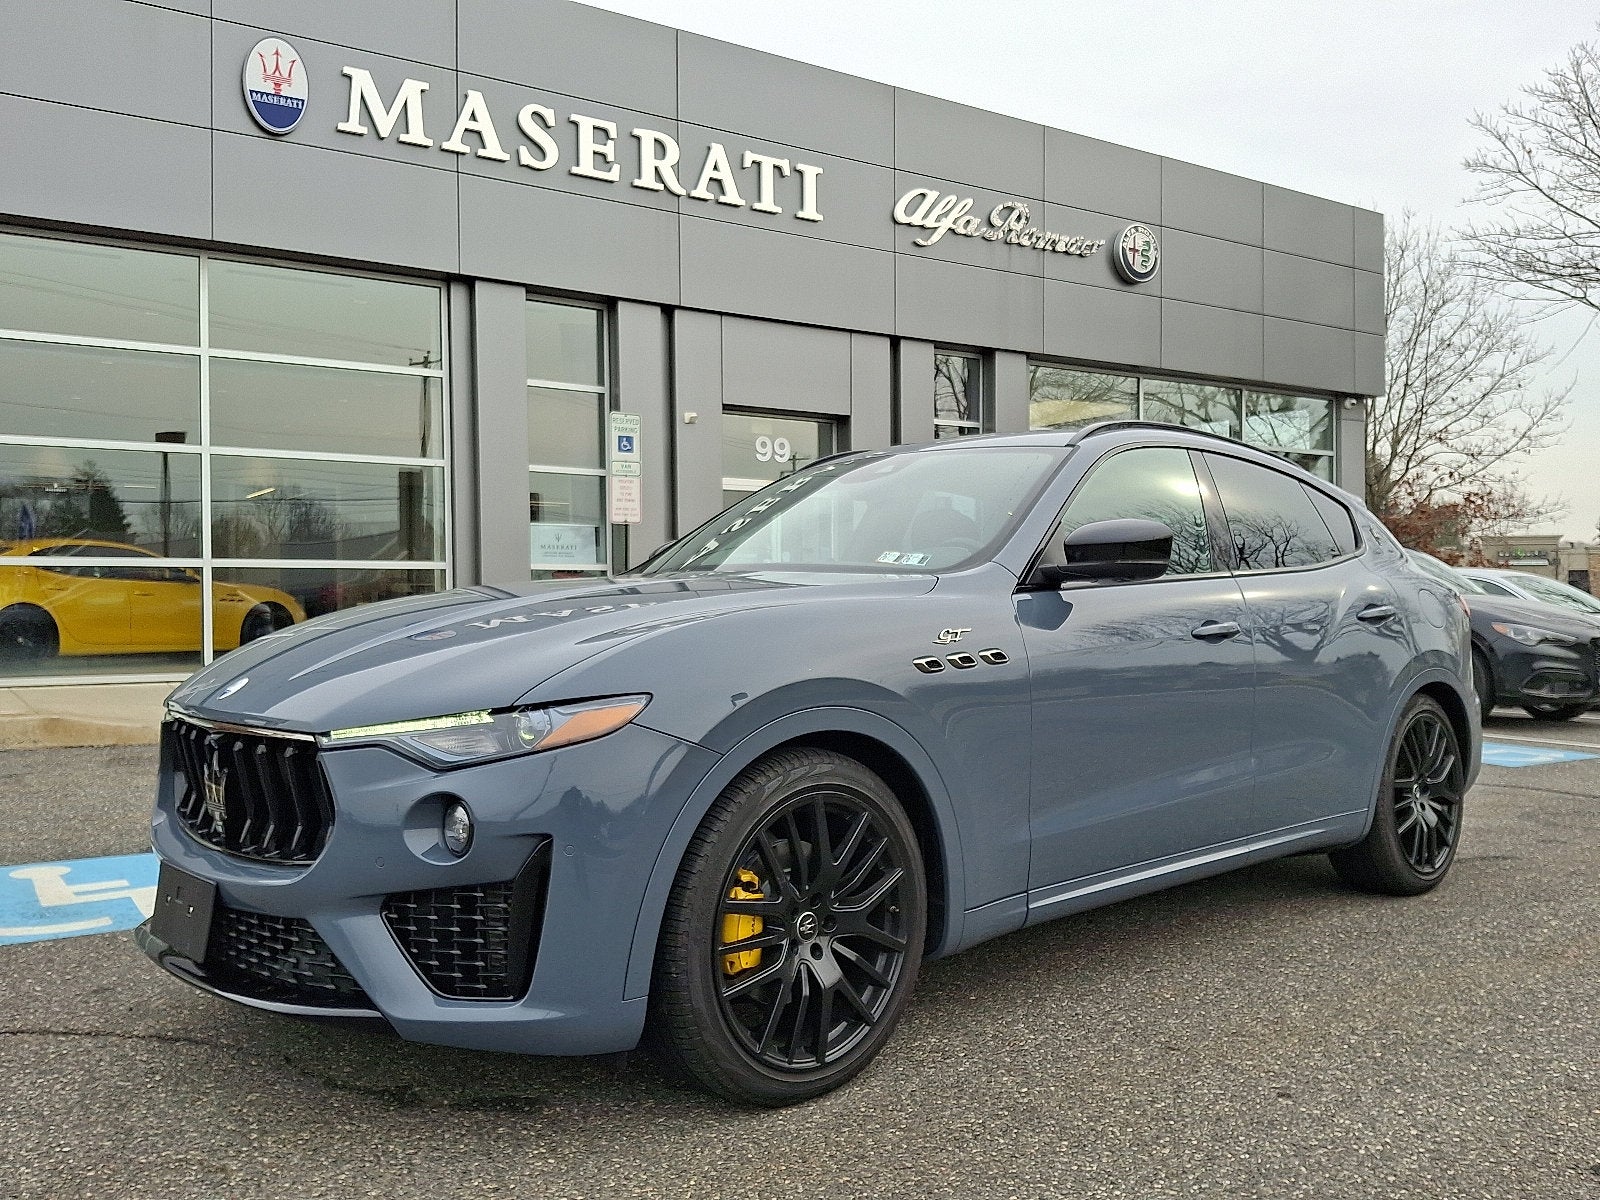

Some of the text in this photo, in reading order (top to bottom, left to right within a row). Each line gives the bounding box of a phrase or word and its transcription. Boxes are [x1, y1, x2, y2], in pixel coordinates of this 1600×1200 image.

[251, 91, 303, 109] MASERATI
[336, 65, 824, 222] MASERATI
[893, 188, 983, 247] Alfa
[612, 417, 640, 426] RESERVED
[614, 426, 638, 434] PARKING
[755, 436, 791, 463] 99
[932, 627, 972, 645] GT
